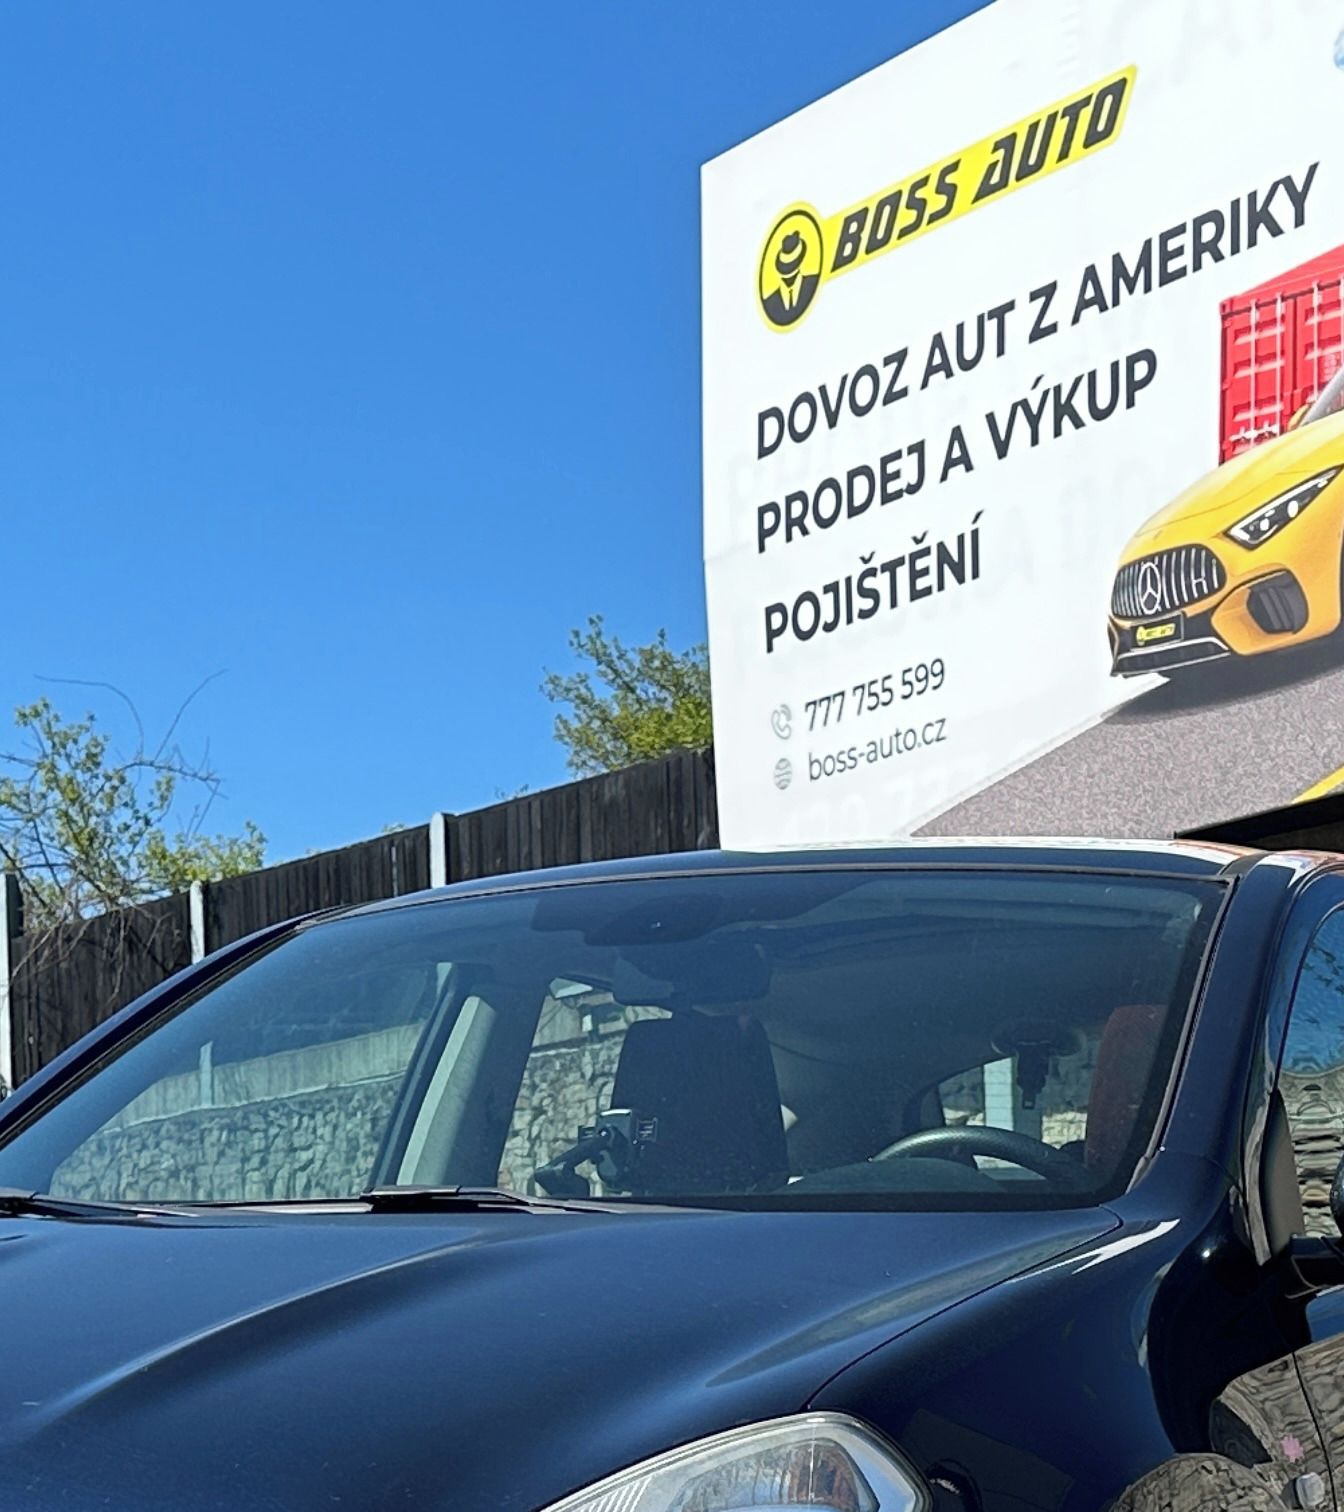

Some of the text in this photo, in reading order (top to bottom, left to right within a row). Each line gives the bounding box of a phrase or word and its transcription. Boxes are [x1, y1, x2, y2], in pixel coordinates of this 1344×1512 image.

[830, 77, 1128, 273] BOSS AUTO
[757, 161, 1320, 460] DOVOZ AUT Z AMERIKY
[757, 348, 1158, 554] PRODEJ A VÝKUP
[765, 509, 984, 654] POJIŠTĚNÍ
[805, 658, 945, 732] 777 755 599
[808, 717, 947, 782] boss-auto.cz
